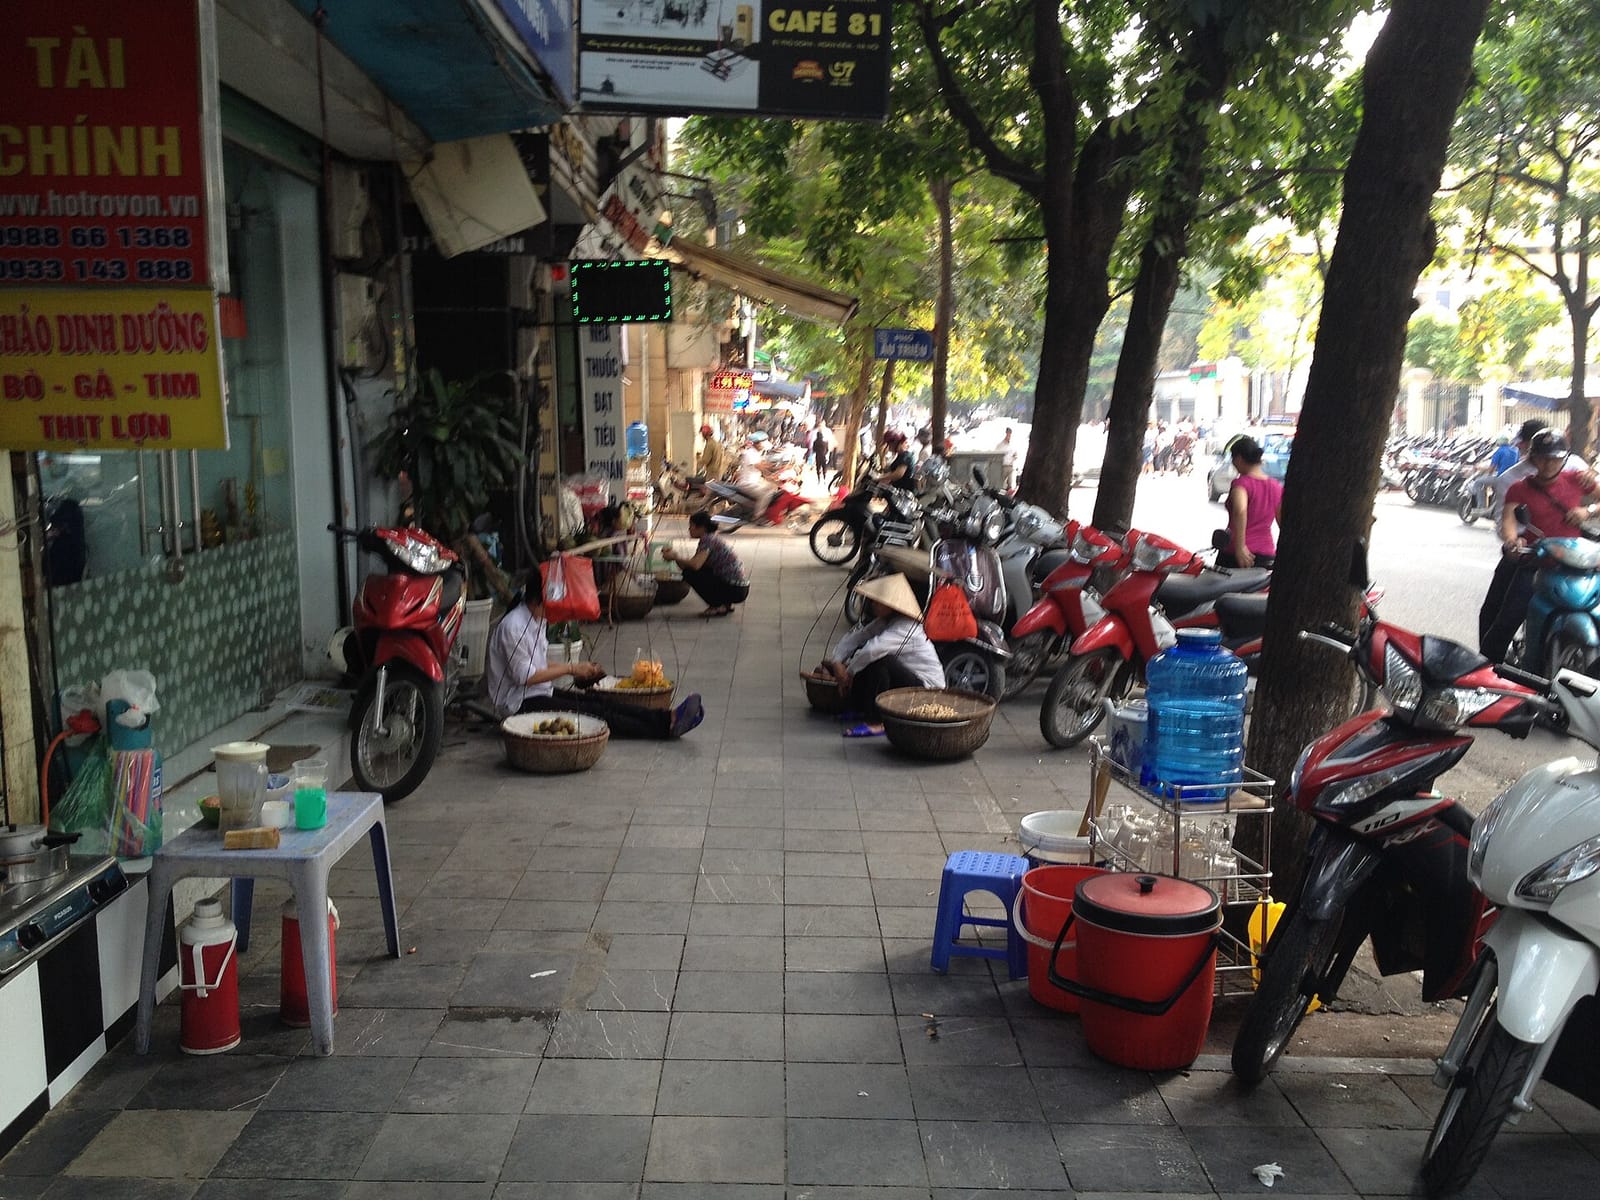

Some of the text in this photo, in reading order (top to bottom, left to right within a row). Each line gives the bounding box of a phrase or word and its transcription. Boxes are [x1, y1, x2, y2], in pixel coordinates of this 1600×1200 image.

[768, 5, 882, 36] CAFÉ 81
[26, 25, 127, 89] TÀI
[70, 227, 107, 248] 66
[117, 227, 192, 248] 1368
[73, 259, 127, 281] 143
[136, 259, 192, 281] 888
[57, 313, 119, 354] DINH
[2, 368, 45, 401] BÒ
[73, 368, 115, 401] GÀ
[143, 372, 201, 400] TIM
[39, 411, 171, 447] THỊT LỢN
